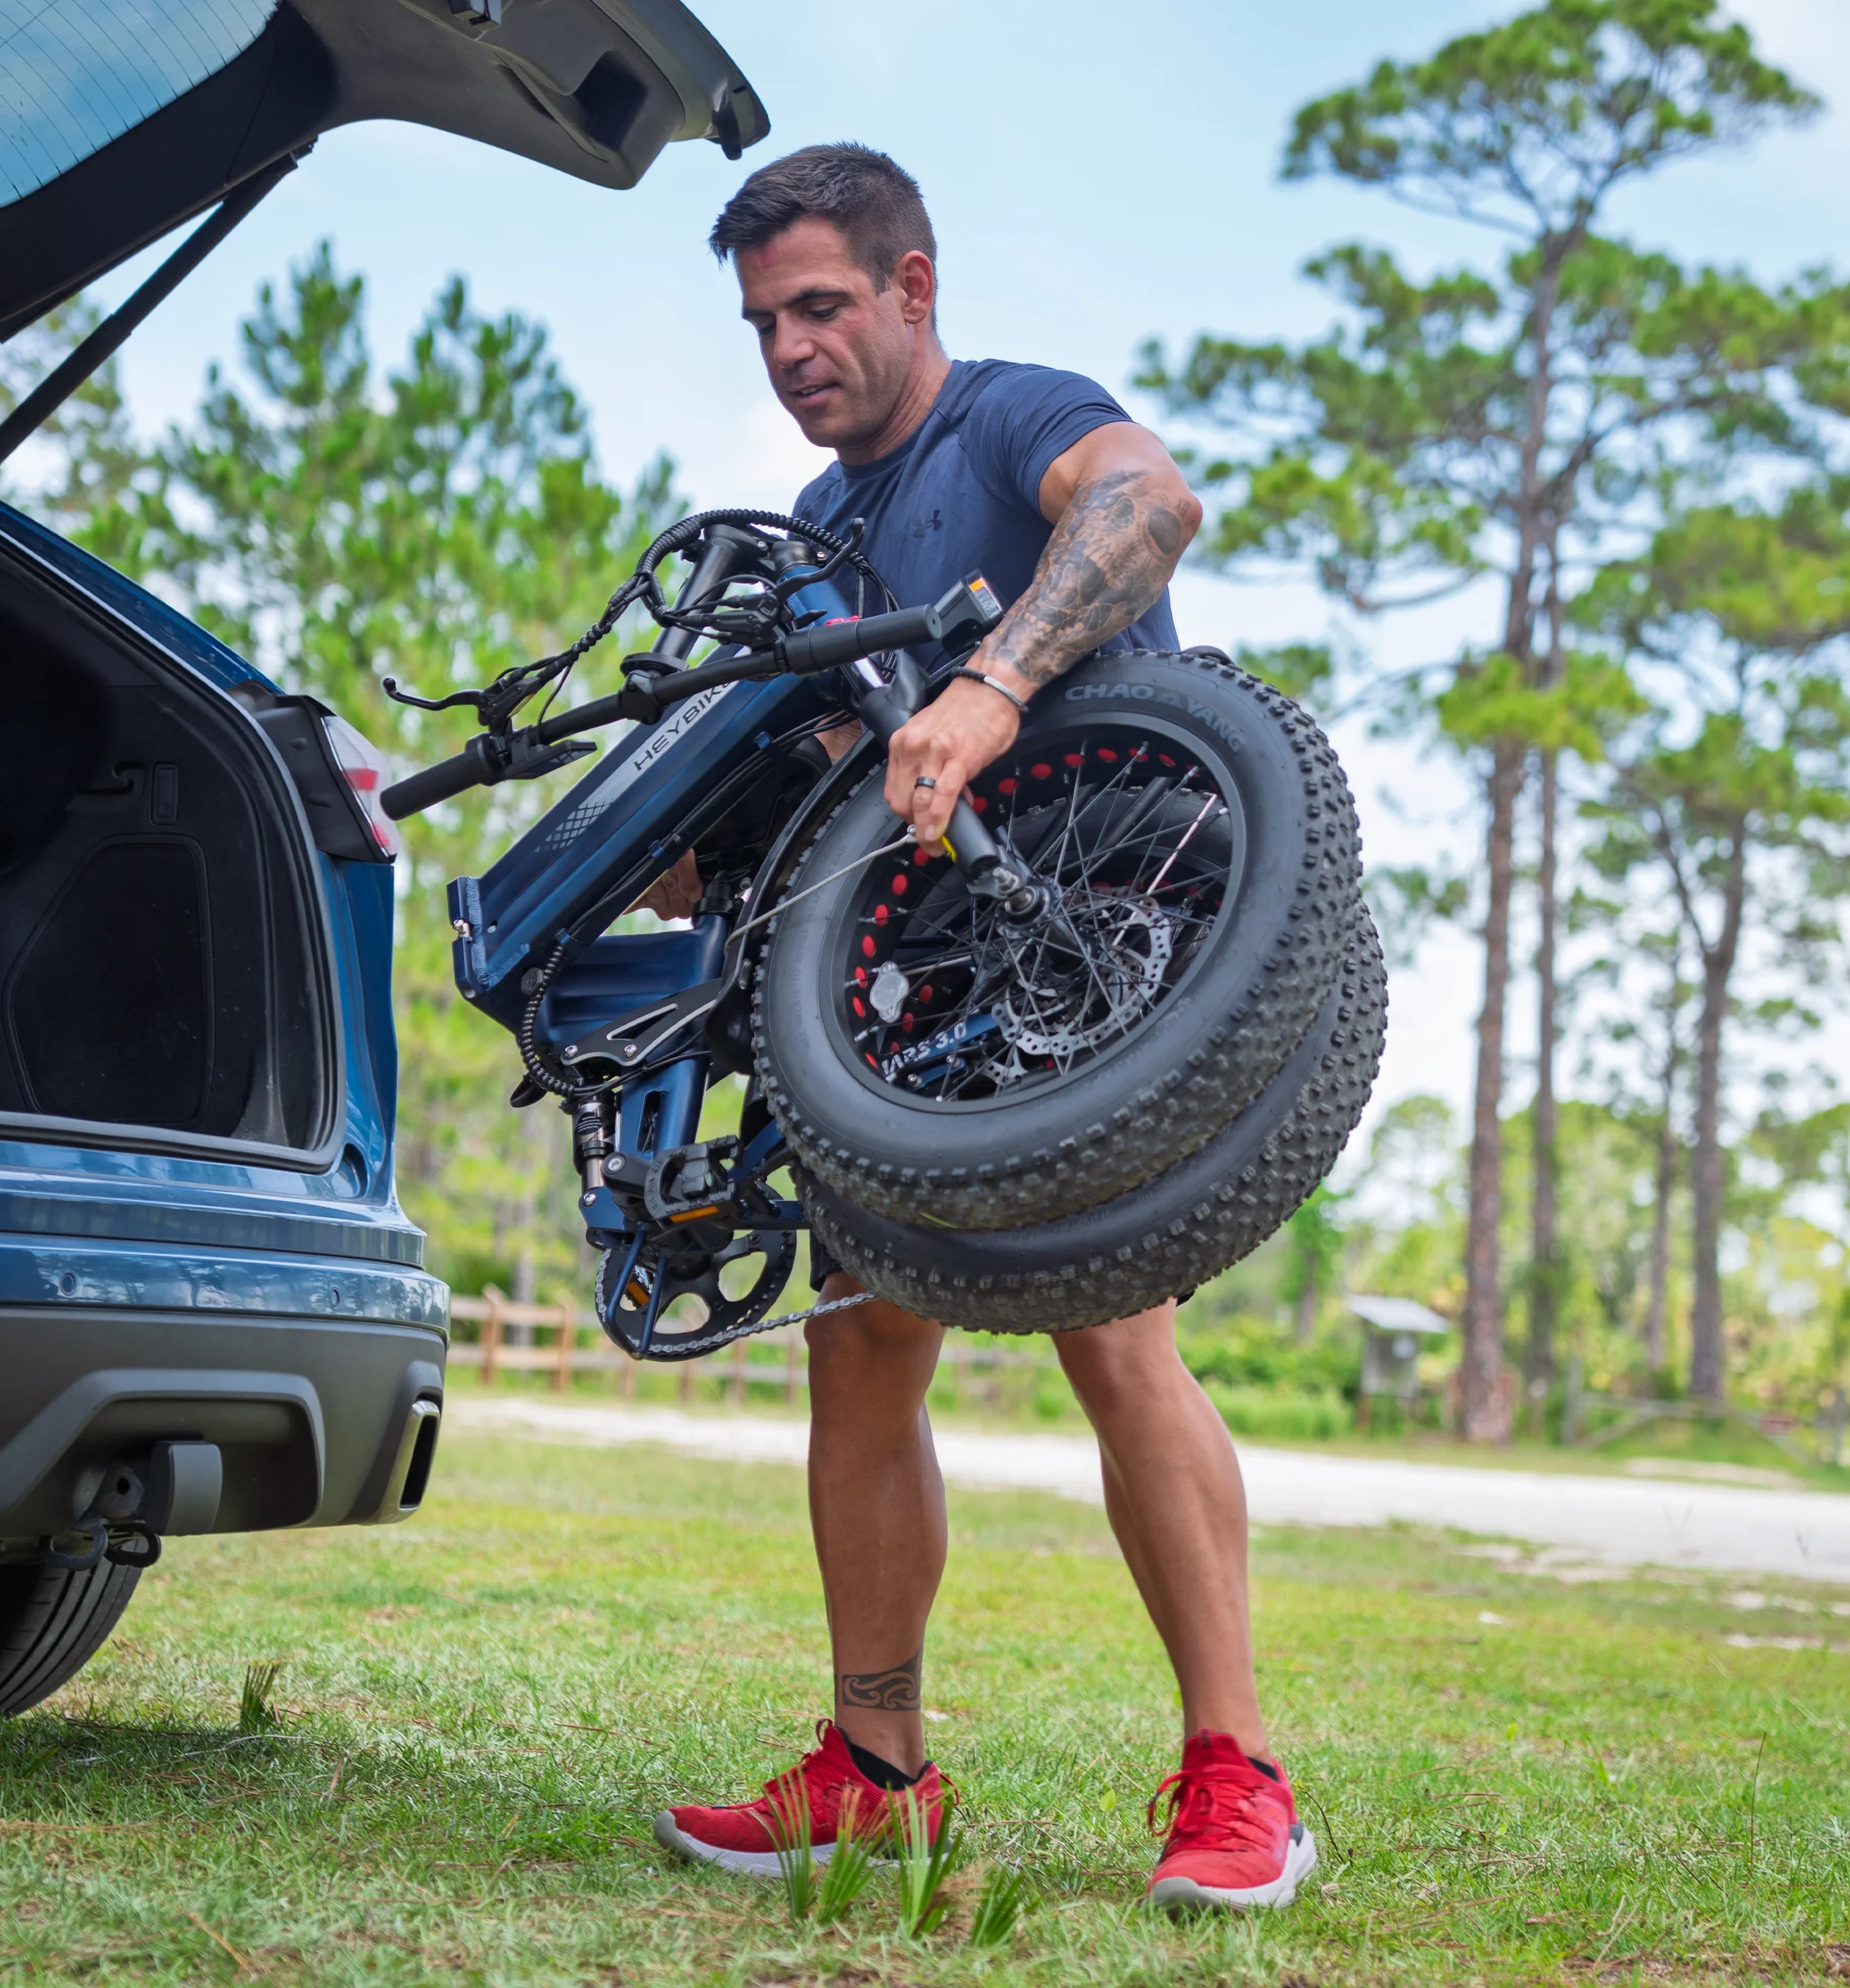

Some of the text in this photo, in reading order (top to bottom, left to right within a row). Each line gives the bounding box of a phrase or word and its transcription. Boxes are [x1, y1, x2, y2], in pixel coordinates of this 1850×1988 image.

[1065, 683, 1154, 701] CHAO
[1186, 697, 1242, 752] YANG
[832, 845, 849, 867] BAR
[935, 1022, 967, 1049] 3.0
